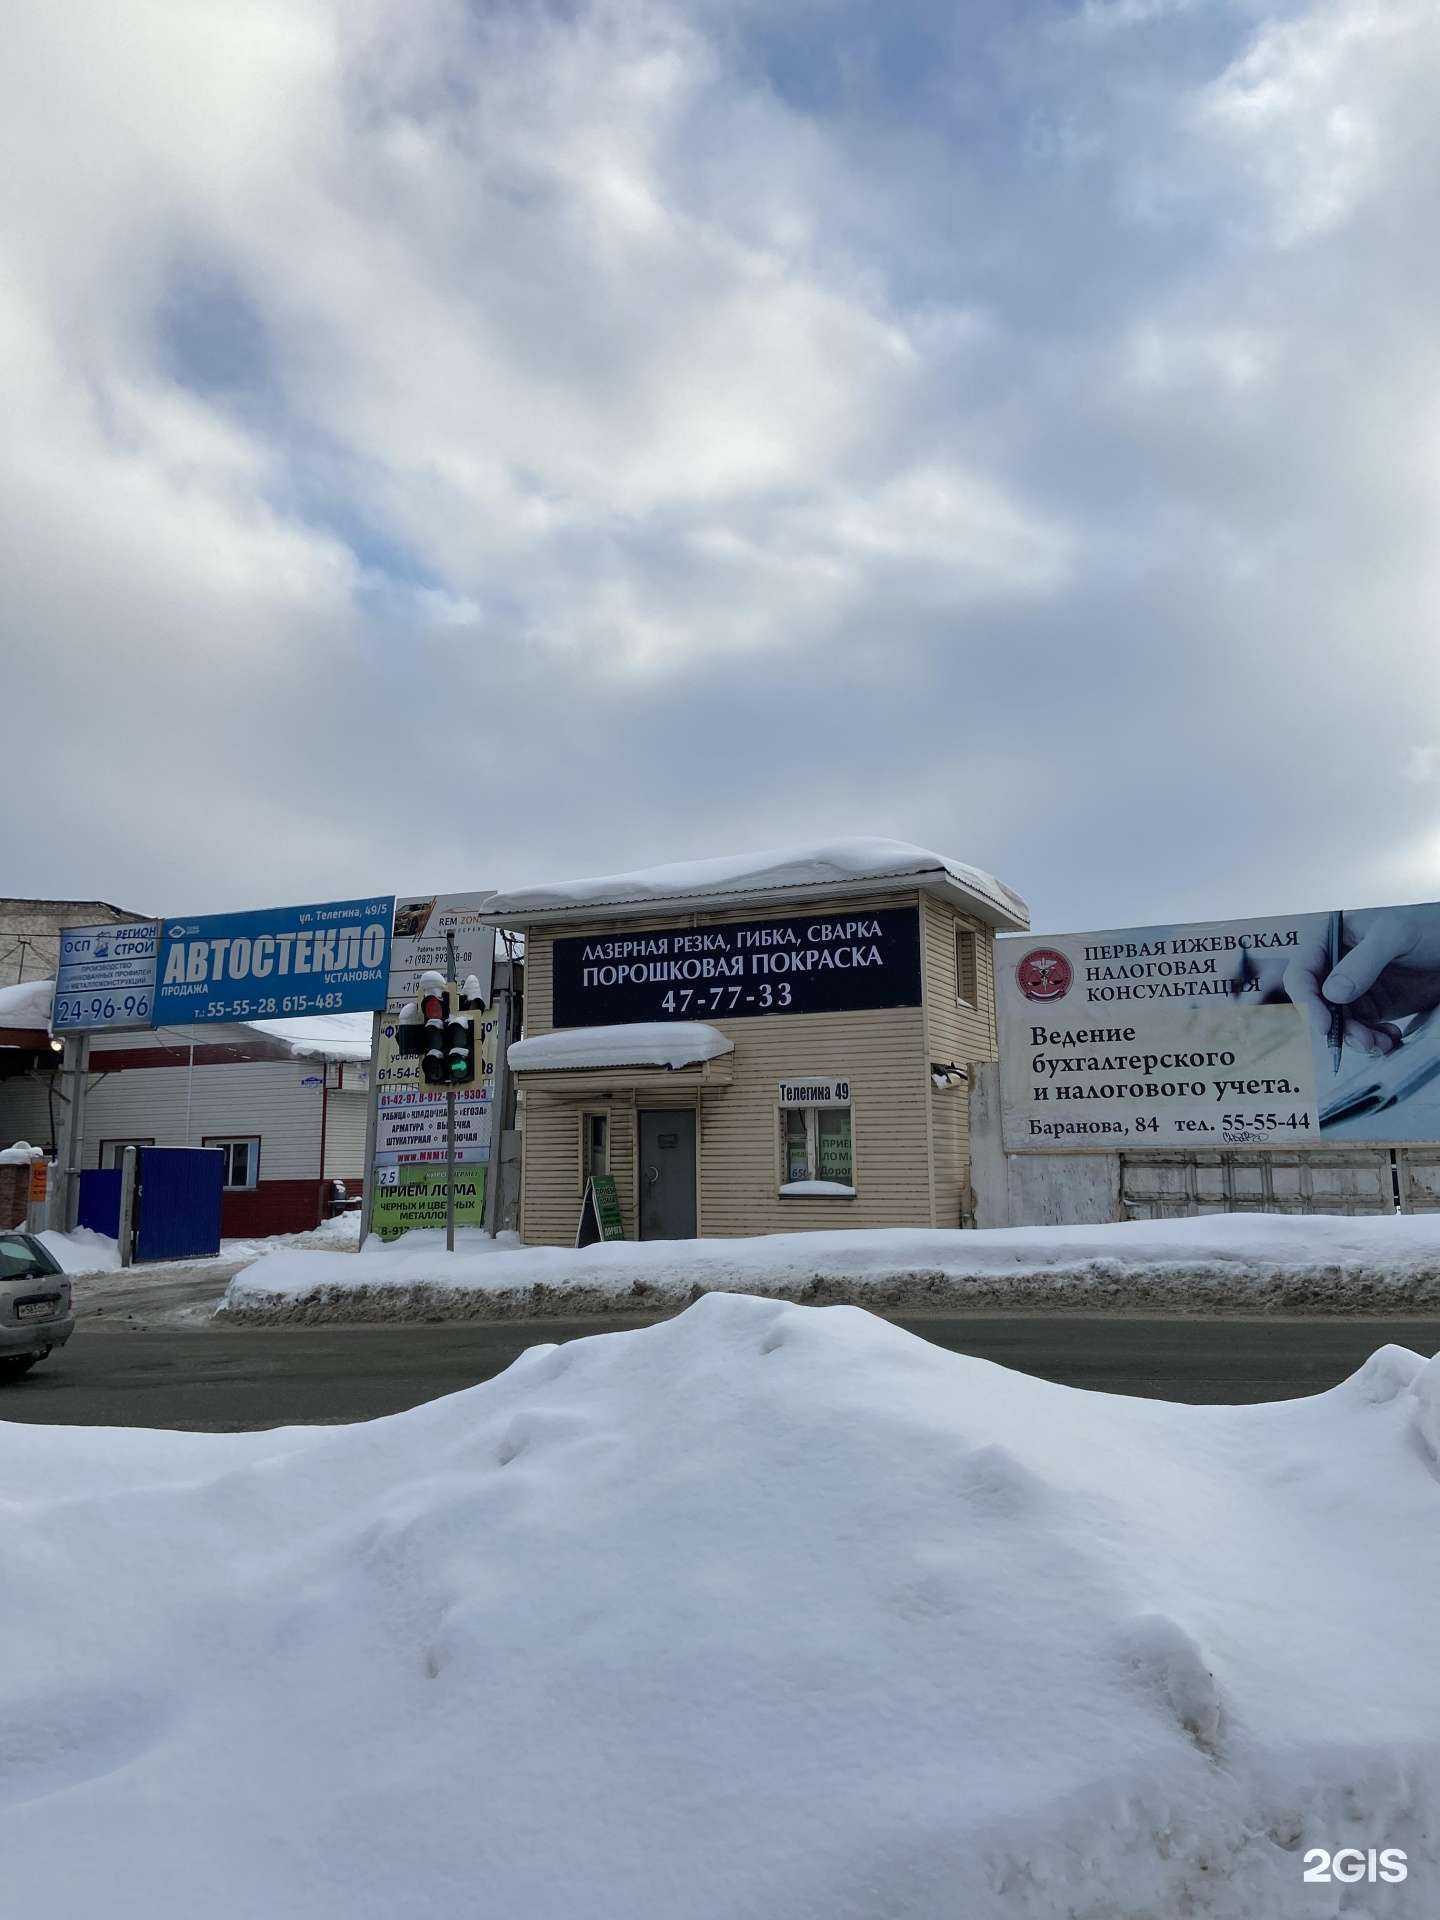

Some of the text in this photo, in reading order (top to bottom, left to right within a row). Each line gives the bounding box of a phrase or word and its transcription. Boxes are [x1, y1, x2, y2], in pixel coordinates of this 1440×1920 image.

[299, 903, 387, 925] ул. Телегина, 49/5
[439, 917, 457, 926] REM
[115, 927, 156, 940] РЕГИОН
[582, 920, 882, 960] ЛАЗЕРНАЯ РЕЗКА, ГИБКА, СВАРКА
[64, 940, 91, 953] ОСП
[114, 940, 154, 955] СТРОЙ
[163, 923, 385, 985] АВТОСТЕКЛО
[1084, 931, 1300, 962] ПЕРВАЯ ИЖЕВСКАЯ
[582, 945, 883, 987] ПОРОШКОВАЯ ПОКРАСКА
[1085, 959, 1217, 981] НАЛОГОВАЯ
[324, 969, 382, 984] УСТАНОВКА
[161, 983, 209, 997] ПРОДАЖА
[661, 982, 793, 1013] 47-77-33
[57, 995, 149, 1021] 24-96-96
[207, 1000, 278, 1017] 55-55-28,
[282, 993, 343, 1011] 615-483
[1030, 1026, 1136, 1048] Ведение
[1032, 1050, 1236, 1079] бухгалтерского
[780, 1082, 849, 1101] Телегина 49
[1033, 1077, 1301, 1102] и налогового учета.
[391, 1120, 471, 1133] АРМАТУРА ВЫЕЧКА
[1028, 1112, 1311, 1139] Баранова, 84 тел. 55-55-44
[386, 1132, 478, 1146] ШТУКАТУРНАЯ КЮЧАЯ
[822, 1139, 851, 1149] ПРИЕ
[823, 1151, 851, 1161] ЛОМ
[380, 1171, 395, 1185] 25
[380, 1181, 428, 1198] ПРИЁМ
[380, 1201, 475, 1211] ЧЕРНЫХ И ЦВЕНЫХ
